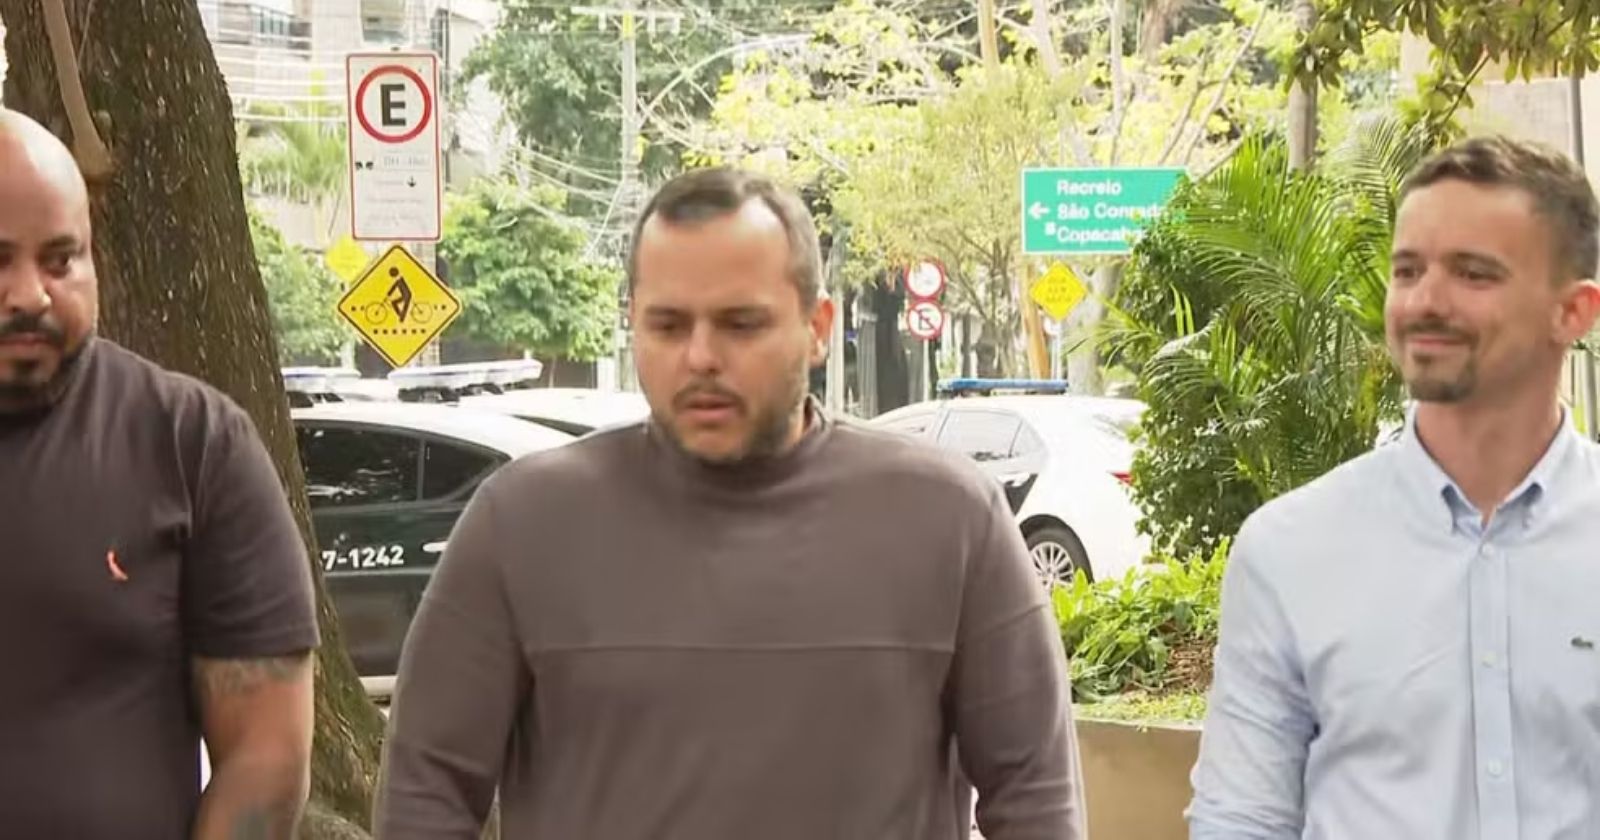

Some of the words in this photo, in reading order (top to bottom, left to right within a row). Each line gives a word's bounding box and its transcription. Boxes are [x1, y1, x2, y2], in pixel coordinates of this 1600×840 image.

[380, 84, 407, 126] E
[1057, 203, 1089, 220] São
[320, 545, 404, 571] 7-1242
